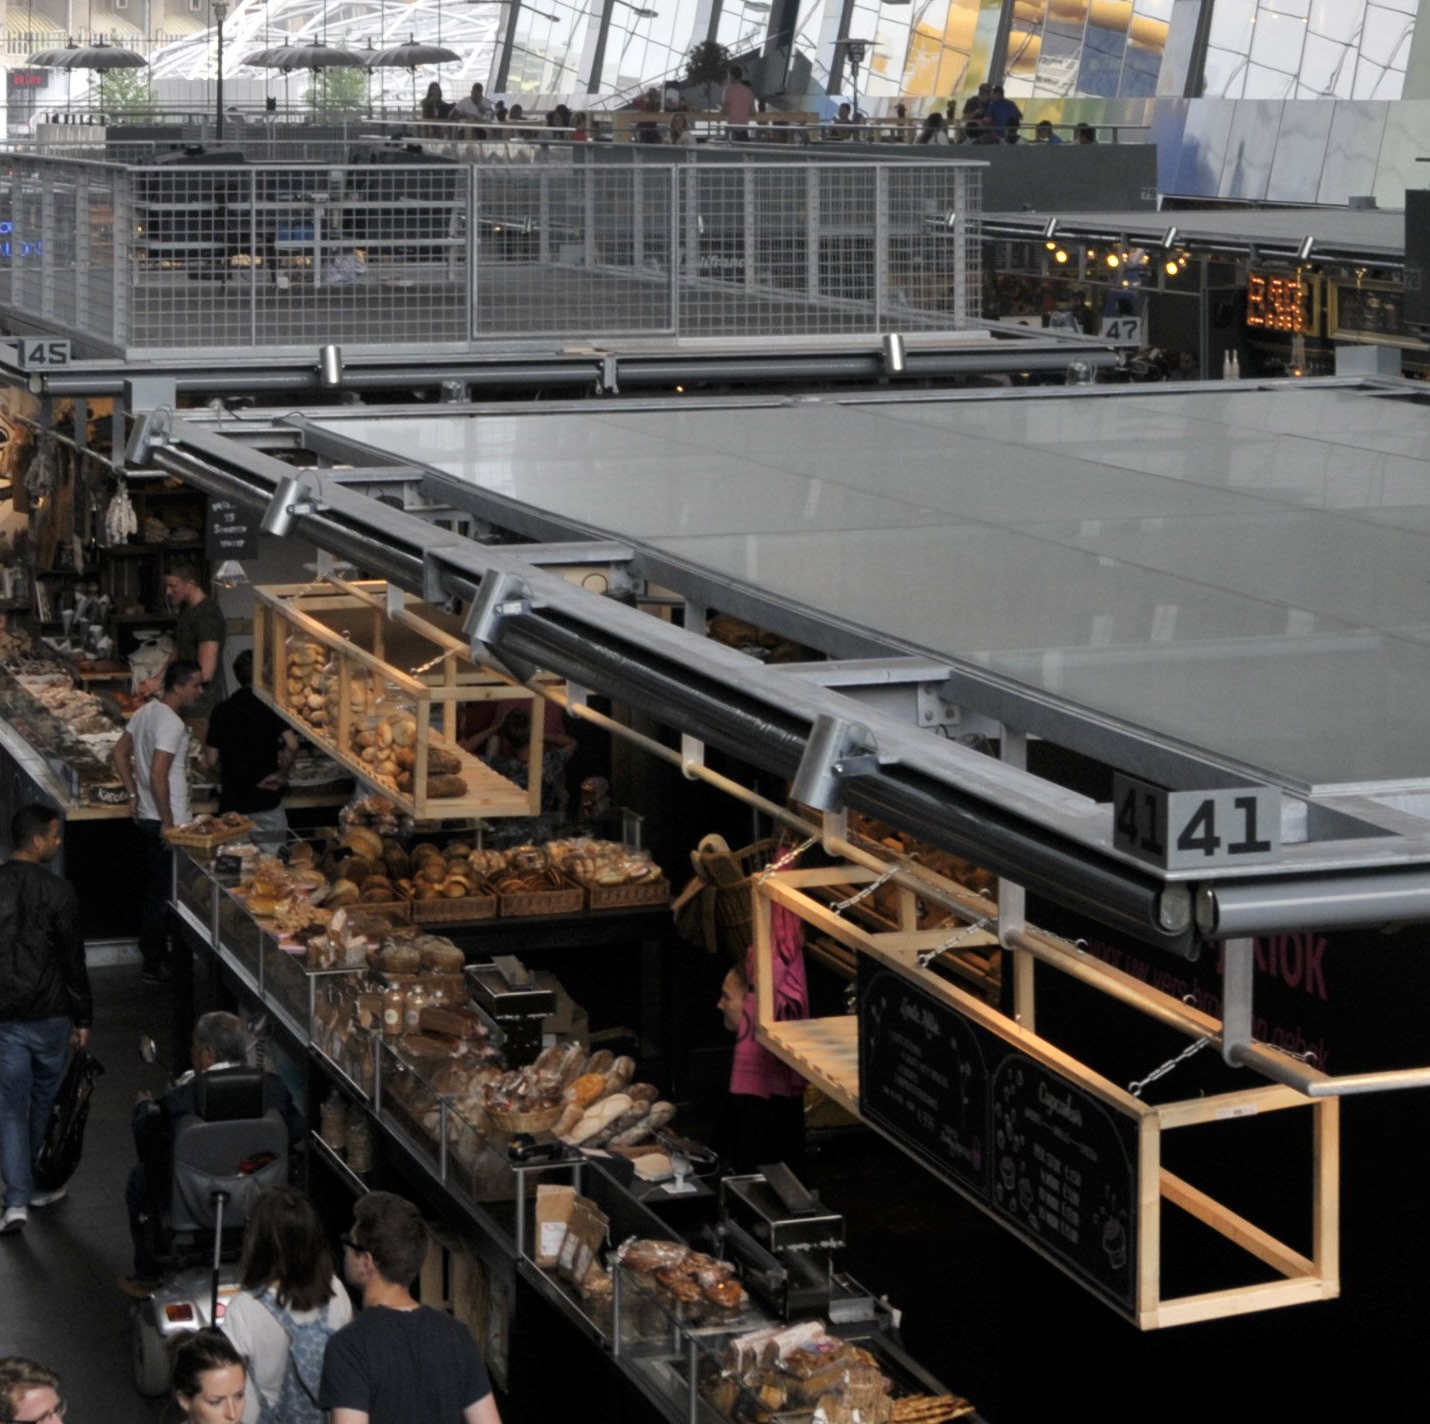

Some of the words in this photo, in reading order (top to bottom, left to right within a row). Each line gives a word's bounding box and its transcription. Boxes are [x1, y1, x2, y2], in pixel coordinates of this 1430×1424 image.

[1106, 320, 1137, 340] 47
[28, 343, 67, 364] 45
[1118, 789, 1163, 856] 41
[1177, 796, 1271, 856] 41
